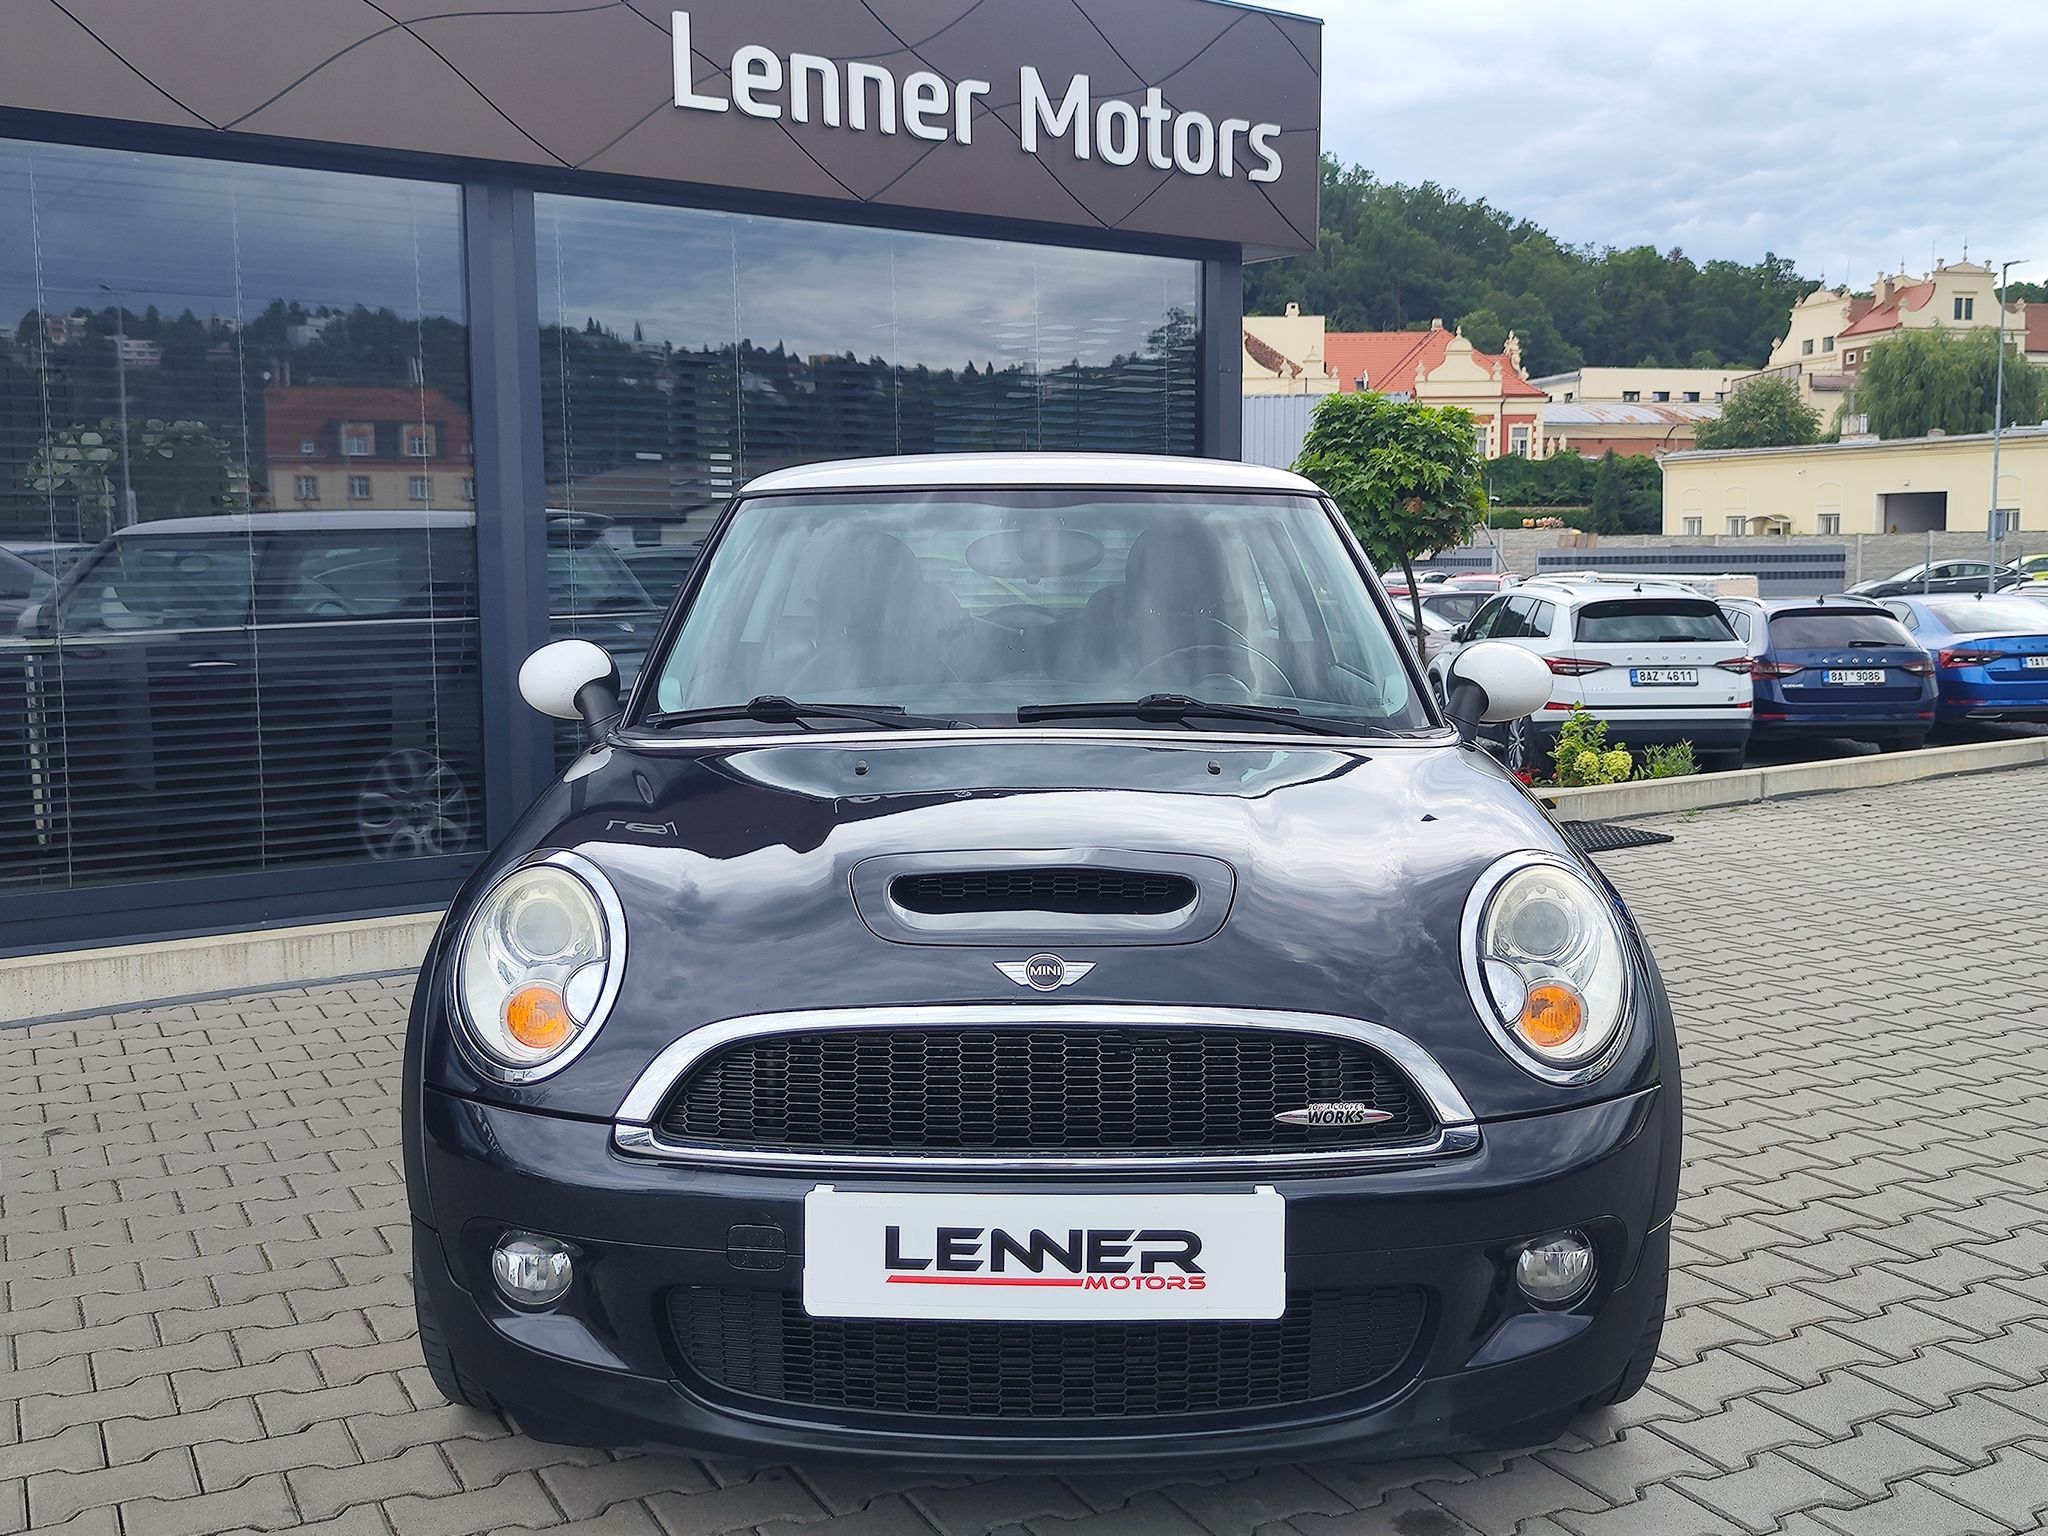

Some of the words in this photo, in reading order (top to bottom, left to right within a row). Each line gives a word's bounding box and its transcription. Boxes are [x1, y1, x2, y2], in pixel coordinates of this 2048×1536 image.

[672, 9, 991, 145] Lenner
[1020, 65, 1283, 183] Motors
[1639, 671, 1659, 681] 8AZ
[1666, 671, 1692, 681] 4611
[1029, 964, 1061, 976] MINI
[1308, 1110, 1365, 1124] WORKS
[885, 1225, 1206, 1274] LENNER
[1084, 1275, 1206, 1290] MOTORS
